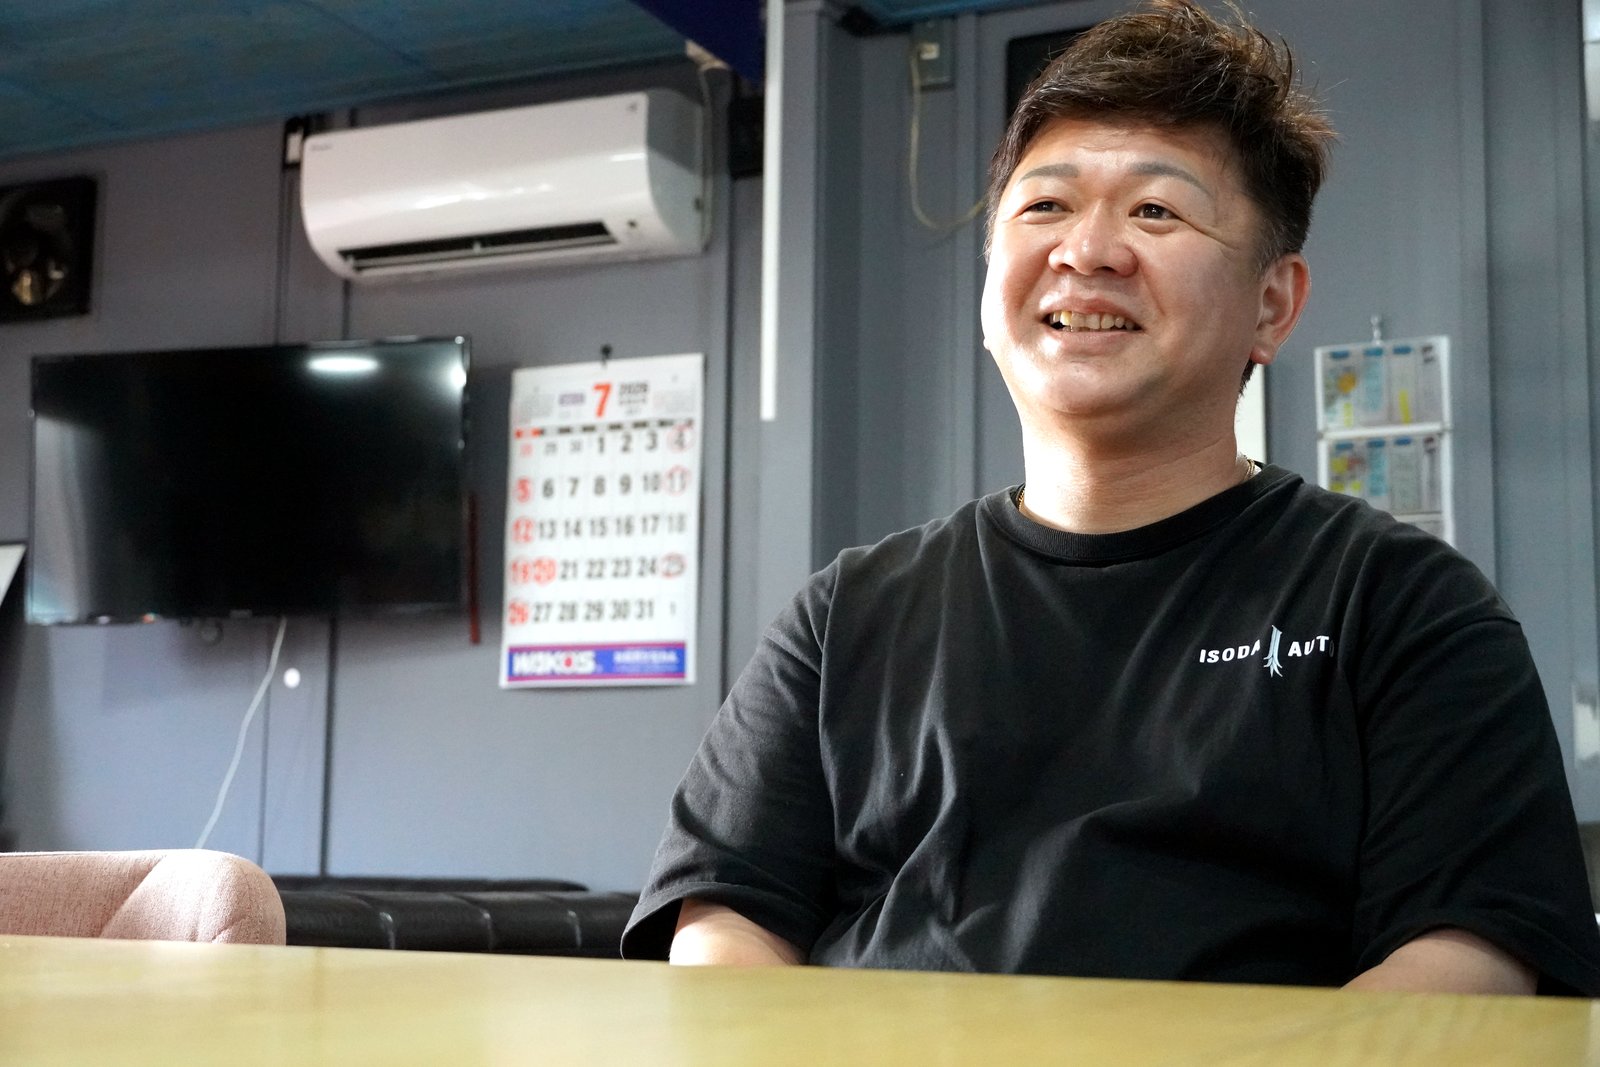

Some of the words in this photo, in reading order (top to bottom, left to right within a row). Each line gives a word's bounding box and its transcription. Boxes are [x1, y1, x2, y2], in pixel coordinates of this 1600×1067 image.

[593, 381, 613, 417] 7
[597, 435, 605, 454] 1
[622, 432, 633, 453] 2
[646, 431, 658, 451] 3
[517, 477, 532, 501] 5
[542, 478, 555, 498] 6
[569, 477, 581, 497] 7
[594, 475, 606, 497] 8
[619, 474, 632, 495] 9
[643, 472, 662, 493] 10
[669, 471, 688, 493] 11
[513, 519, 533, 543] 12
[538, 519, 557, 539] 13
[564, 518, 582, 538] 14
[590, 516, 608, 537] 15
[615, 516, 634, 536] 16
[641, 514, 660, 535] 17
[667, 513, 687, 534] 18
[560, 559, 579, 580] 21
[586, 558, 606, 579] 22
[611, 557, 632, 578] 23
[638, 557, 658, 578] 24
[509, 601, 530, 625] 26
[533, 602, 552, 622] 27
[558, 601, 578, 622] 28
[584, 600, 604, 621] 29
[610, 600, 631, 621] 30
[634, 599, 654, 619] 31
[1200, 639, 1260, 663] ISODA
